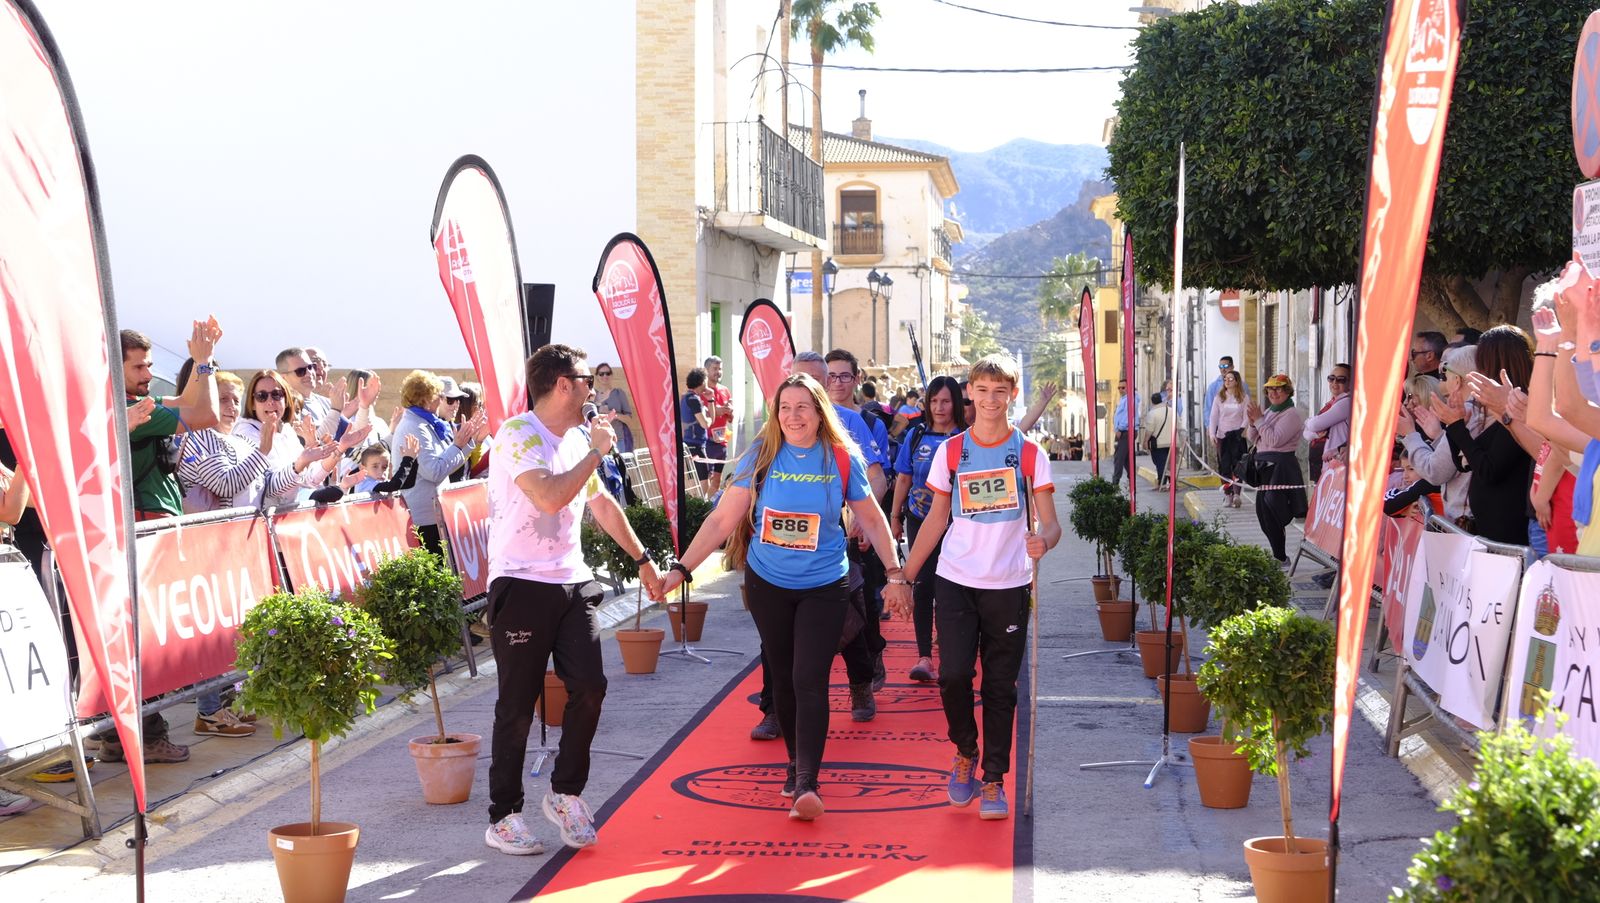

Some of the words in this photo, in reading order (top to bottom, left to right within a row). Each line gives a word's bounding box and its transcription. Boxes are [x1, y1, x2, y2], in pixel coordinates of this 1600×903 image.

[770, 470, 836, 483] DYNAFIT
[968, 478, 1006, 495] 612
[772, 519, 809, 533] 686
[141, 567, 259, 647] VEOLIA
[723, 769, 891, 779] POLORA
[905, 771, 947, 780] LA
[692, 840, 850, 849] Cantoria
[662, 850, 929, 861] Ayuntamiento
